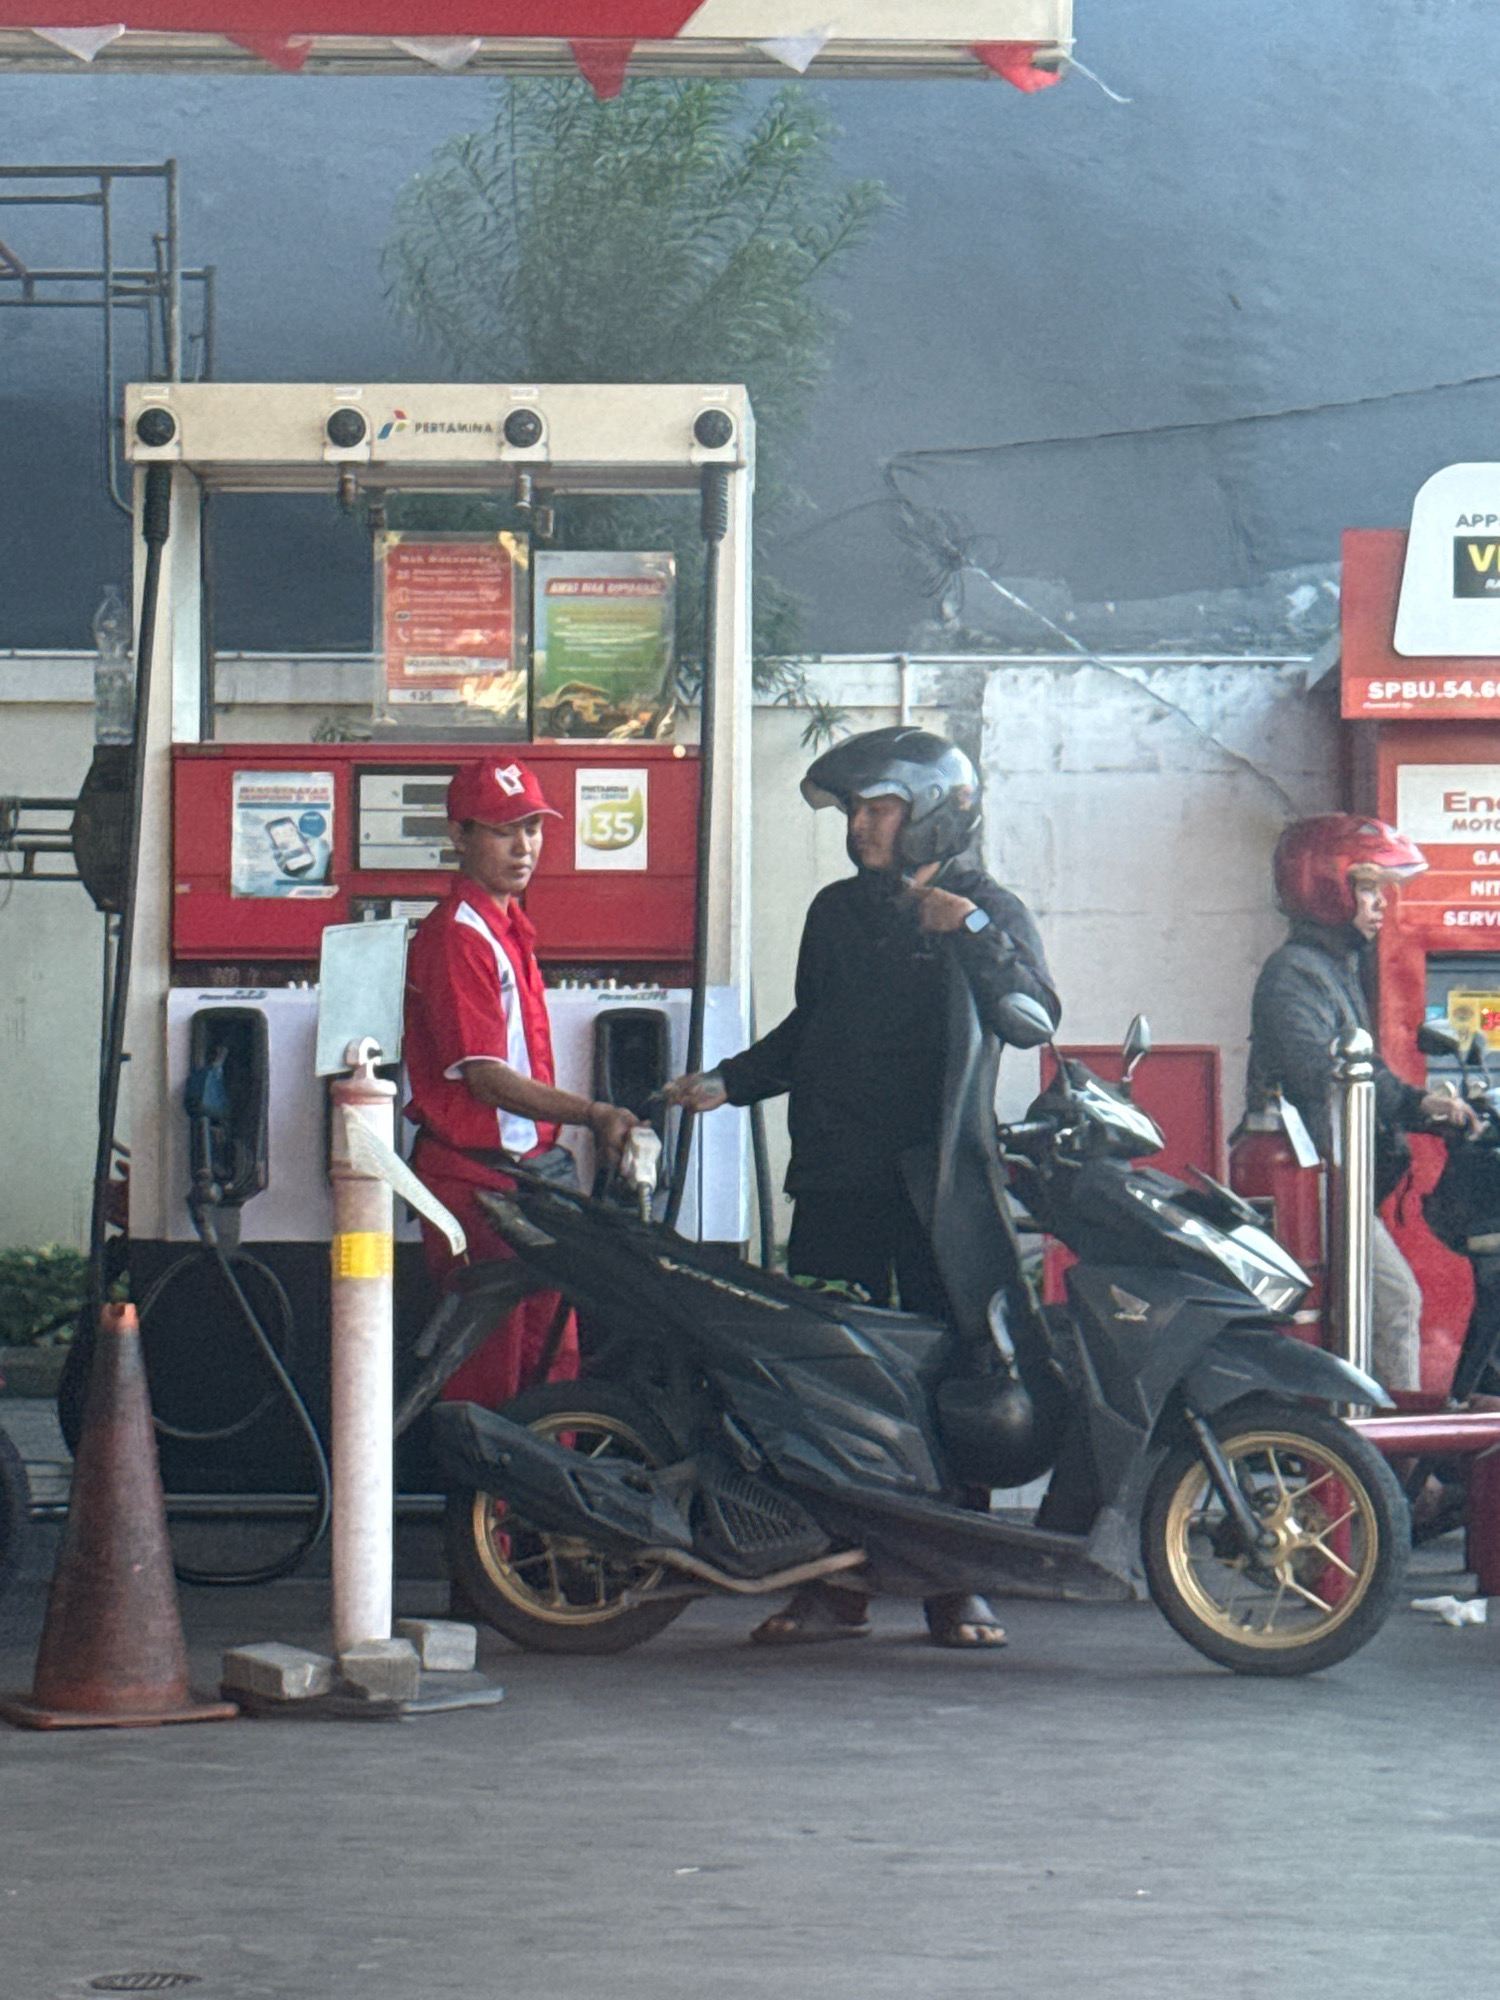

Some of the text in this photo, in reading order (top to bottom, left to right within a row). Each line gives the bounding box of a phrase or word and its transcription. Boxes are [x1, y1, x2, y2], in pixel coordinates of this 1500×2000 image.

[414, 421, 493, 434] PERTAMINA
[1367, 680, 1500, 699] SPBU.54.6
[582, 812, 635, 842] 135
[1442, 910, 1500, 927] SERV
